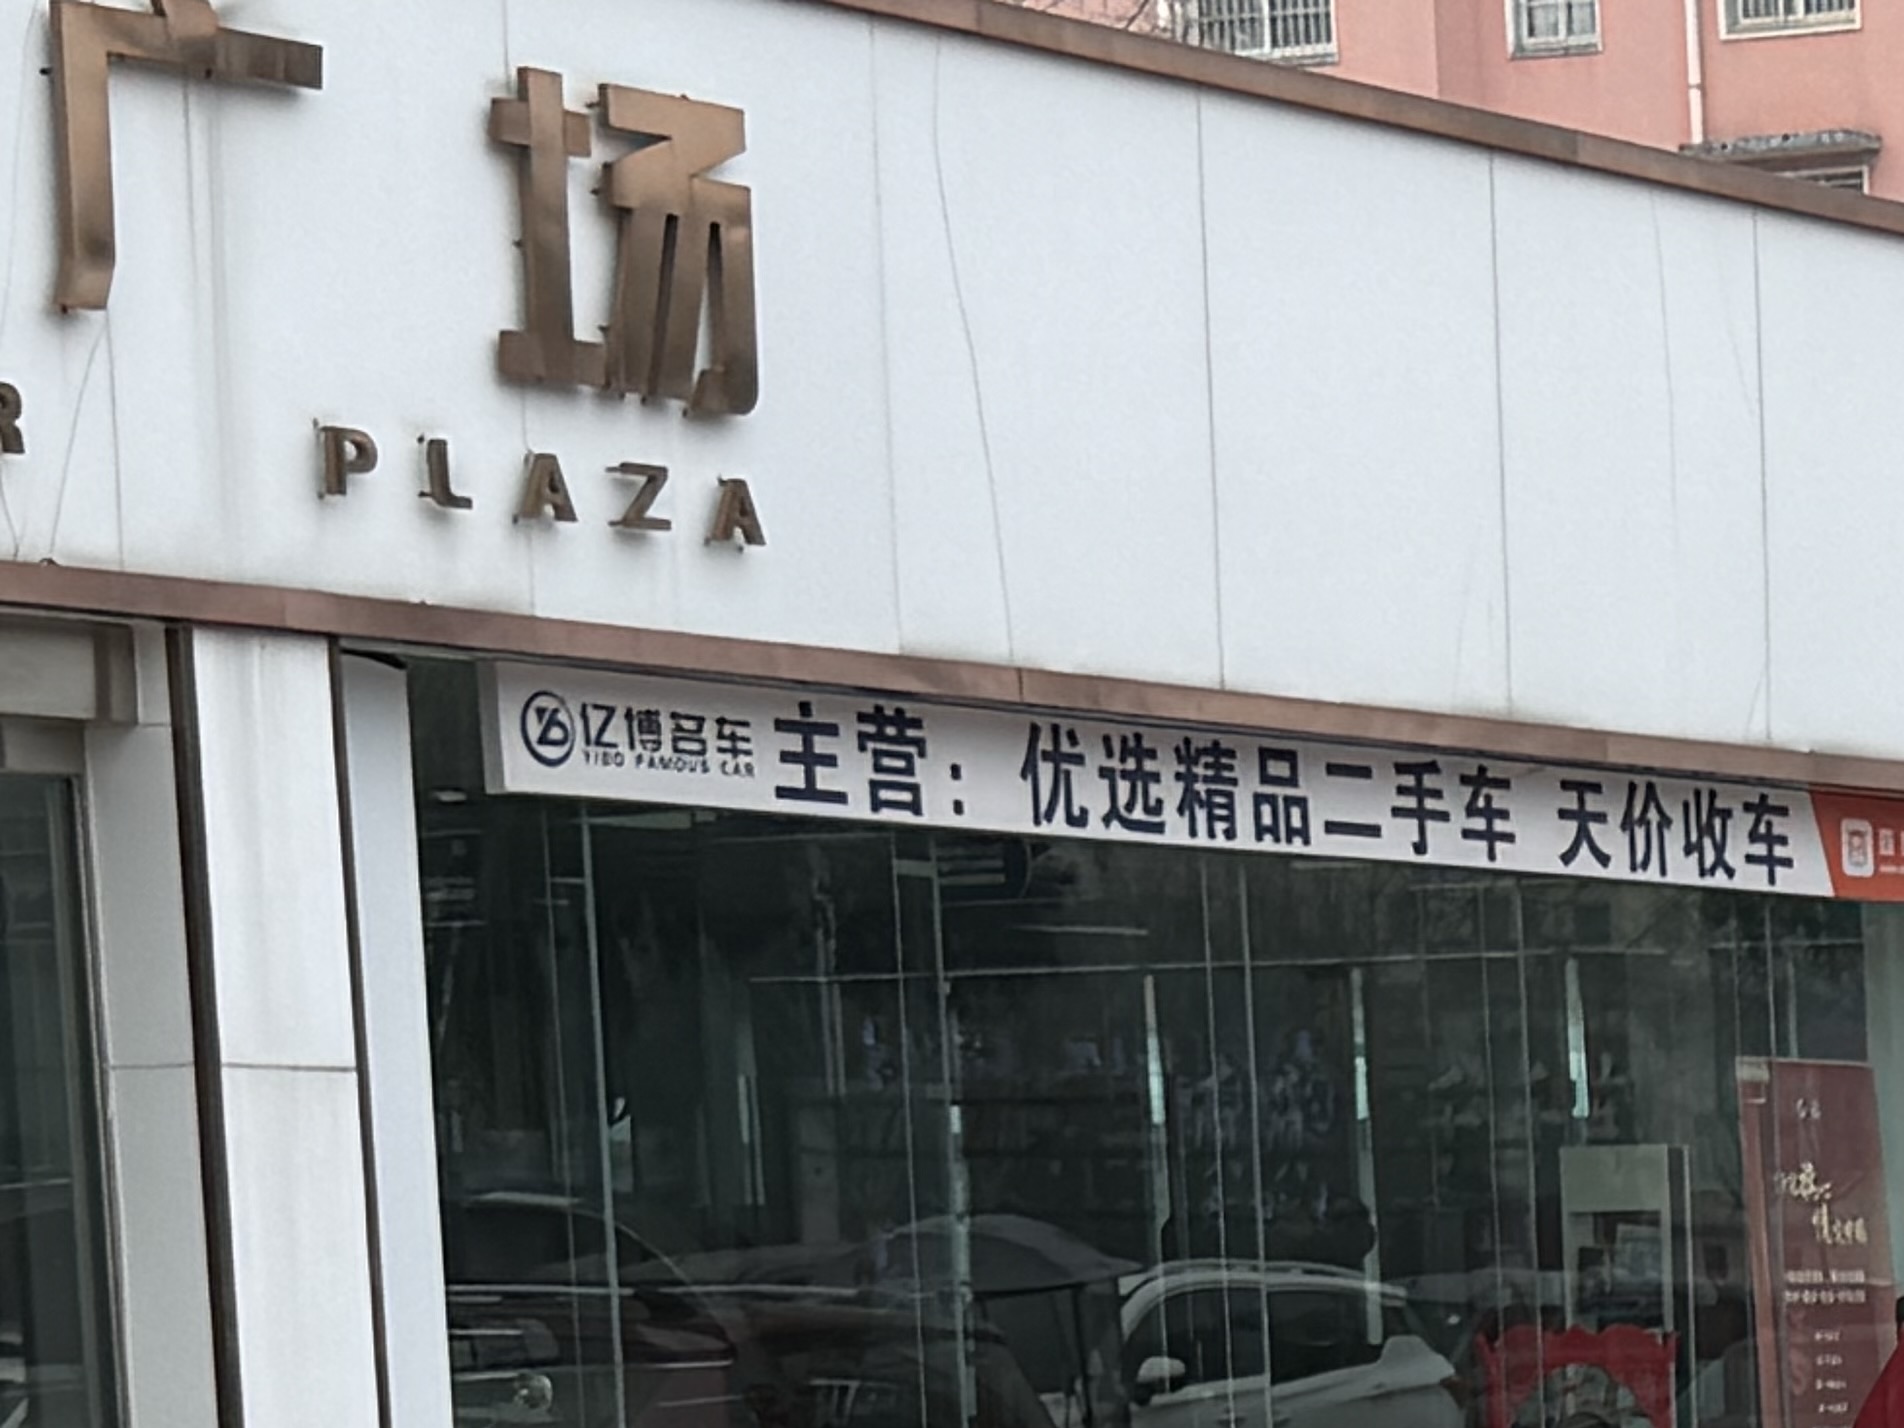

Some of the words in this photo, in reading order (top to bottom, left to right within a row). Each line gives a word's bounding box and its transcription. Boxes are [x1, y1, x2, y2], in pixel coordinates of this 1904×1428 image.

[316, 422, 766, 548] PLAZA
[579, 702, 755, 762] 亿博名车
[634, 754, 710, 775] FAMOUS
[719, 760, 757, 779] CAR
[1018, 722, 1517, 863] 优选精品二手车
[1556, 778, 1795, 886] 天价收车
